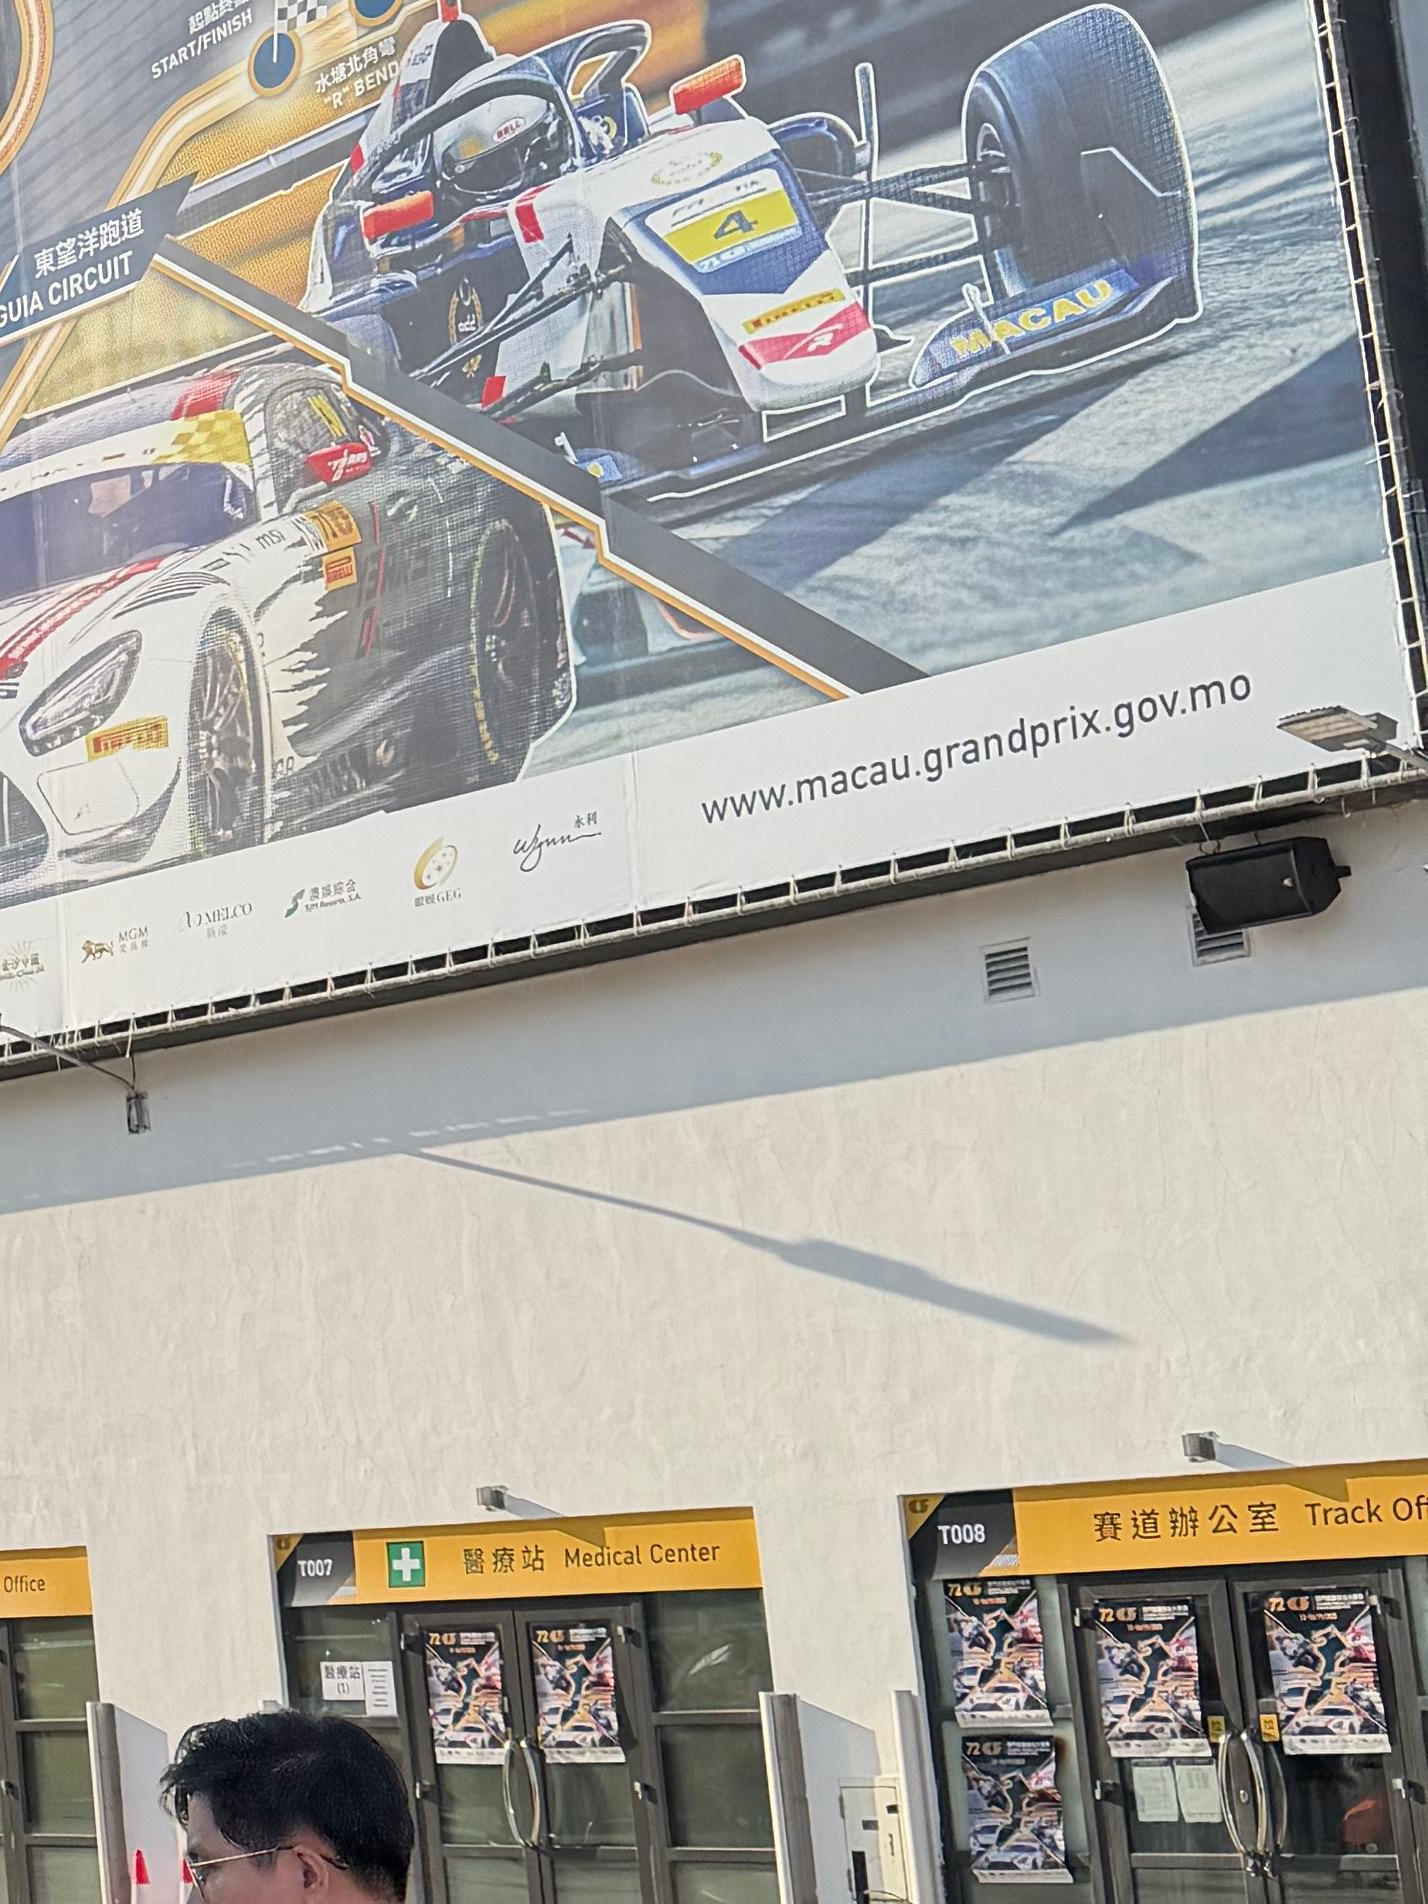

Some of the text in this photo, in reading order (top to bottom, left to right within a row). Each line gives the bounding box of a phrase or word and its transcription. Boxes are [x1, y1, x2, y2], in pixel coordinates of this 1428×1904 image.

[151, 8, 253, 79] START/FINISH
[354, 60, 400, 97] BEND
[714, 210, 758, 239] 4
[34, 208, 144, 278] 東望洋跑道
[48, 251, 133, 306] CIRCUIT
[950, 279, 1113, 359] MACAU
[701, 673, 1252, 825] www.macau.grandprix.gov.mo
[204, 902, 253, 925] MELCO
[119, 927, 149, 943] MGM
[938, 1522, 986, 1545] T008
[1093, 1494, 1428, 1543] 賽道辦公室 Track Of
[297, 1557, 333, 1578] T007
[461, 1541, 721, 1575] 醫療站 Medical Center
[3, 1575, 46, 1595] Office
[1099, 1608, 1115, 1623] 72
[1270, 1597, 1286, 1612] 72
